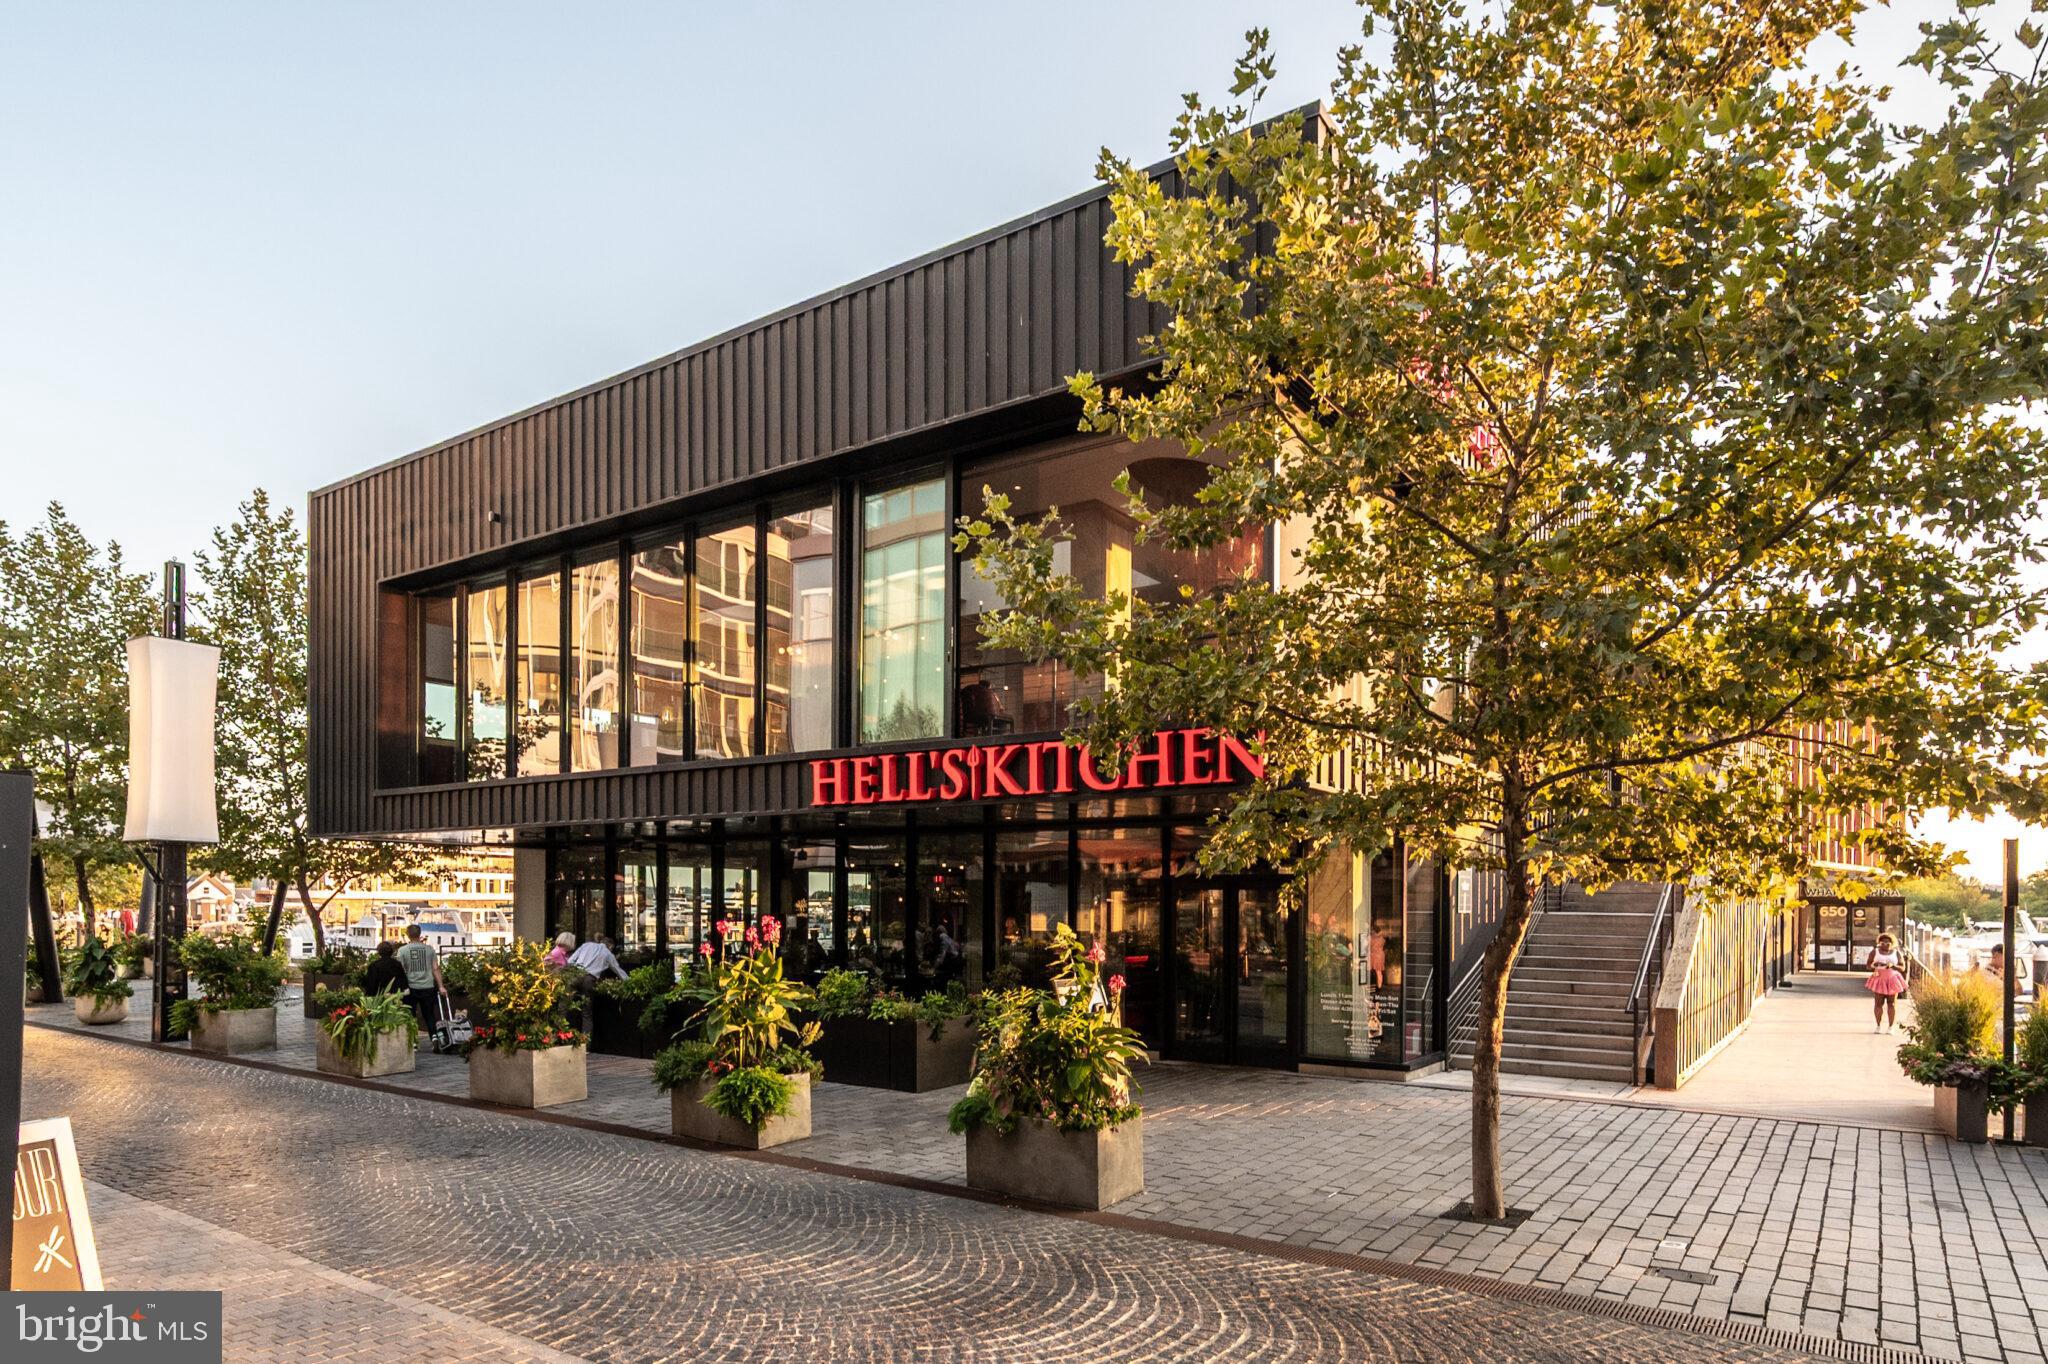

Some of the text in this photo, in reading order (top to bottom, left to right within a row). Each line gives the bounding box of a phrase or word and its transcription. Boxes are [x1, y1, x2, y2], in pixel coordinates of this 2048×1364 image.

[809, 727, 1267, 807] HELL'S KITCHEN
[1804, 887, 1837, 897] WHA
[1819, 905, 1848, 918] 650
